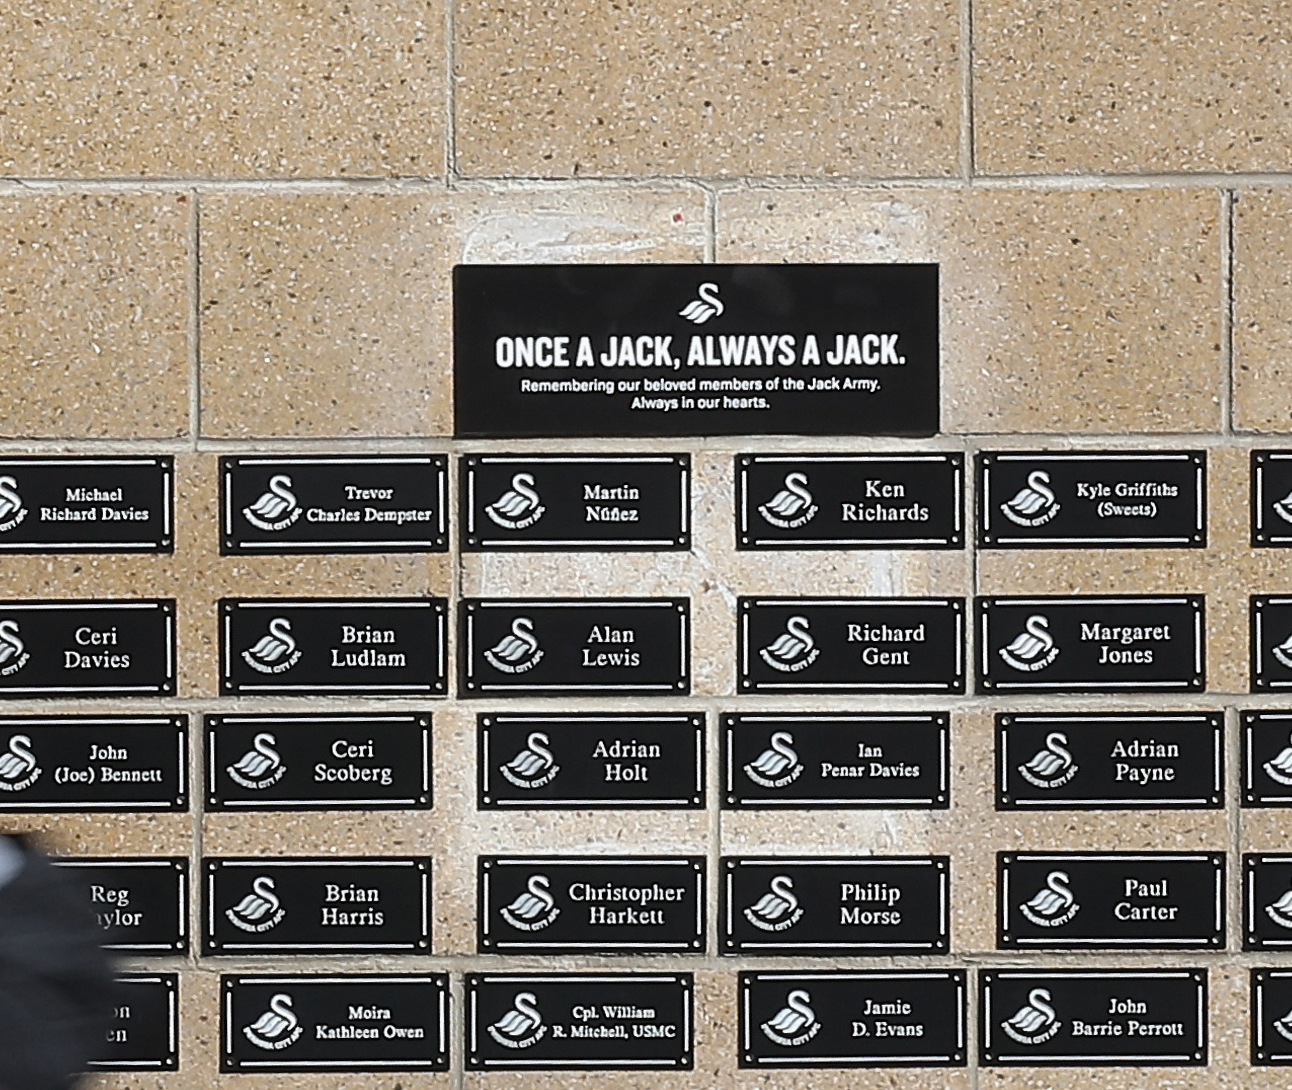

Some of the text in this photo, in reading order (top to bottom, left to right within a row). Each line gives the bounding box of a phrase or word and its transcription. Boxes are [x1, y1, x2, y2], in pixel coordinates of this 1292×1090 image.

[495, 333, 906, 370] ONCE A JACK, ALWAYS A JACK.
[521, 376, 881, 395] Remembering our beloved members of the Jack Army.
[630, 395, 771, 412] Always in our hearts.
[65, 487, 123, 502] Michael
[344, 485, 394, 500] Trevor
[583, 484, 640, 500] Martin
[865, 480, 905, 498] Ken
[40, 507, 150, 521] Richard Davies
[841, 502, 929, 522] Richards
[1097, 501, 1157, 518] (Sweets)
[75, 626, 117, 646] Ceri
[341, 625, 395, 644] Brian
[587, 625, 635, 643] Alan
[847, 623, 925, 642] Richard
[1080, 622, 1171, 645] Margaret
[64, 650, 130, 669] Davies
[330, 649, 406, 667] Ludlam
[582, 648, 640, 667] Lewis
[862, 647, 910, 665] Gent
[1098, 645, 1153, 664] Jones
[89, 744, 128, 760] John
[331, 739, 374, 759] Ceri
[592, 739, 661, 758] Adrian
[858, 743, 883, 758] Ian
[1110, 739, 1179, 758] Adrian
[54, 766, 163, 785] (Joe) Bennett
[314, 763, 393, 786] Scoberg
[604, 763, 648, 782] Holt
[821, 762, 920, 778] Penar Davies
[1115, 763, 1175, 785] Payne
[90, 885, 130, 907] Reg
[325, 883, 379, 902] Brian
[568, 882, 686, 902] Christopher
[841, 882, 901, 907] Philip
[1125, 879, 1168, 897] Paul
[321, 907, 384, 926] Harris
[589, 900, 664, 925] Harkett
[840, 906, 901, 925] Morse
[1114, 902, 1179, 921] Carter
[348, 1005, 391, 1020] Moira
[863, 999, 912, 1015] Jamie
[1108, 998, 1147, 1014] John
[315, 1024, 424, 1039] Kathleen Owen
[851, 1021, 924, 1037] D. Evans
